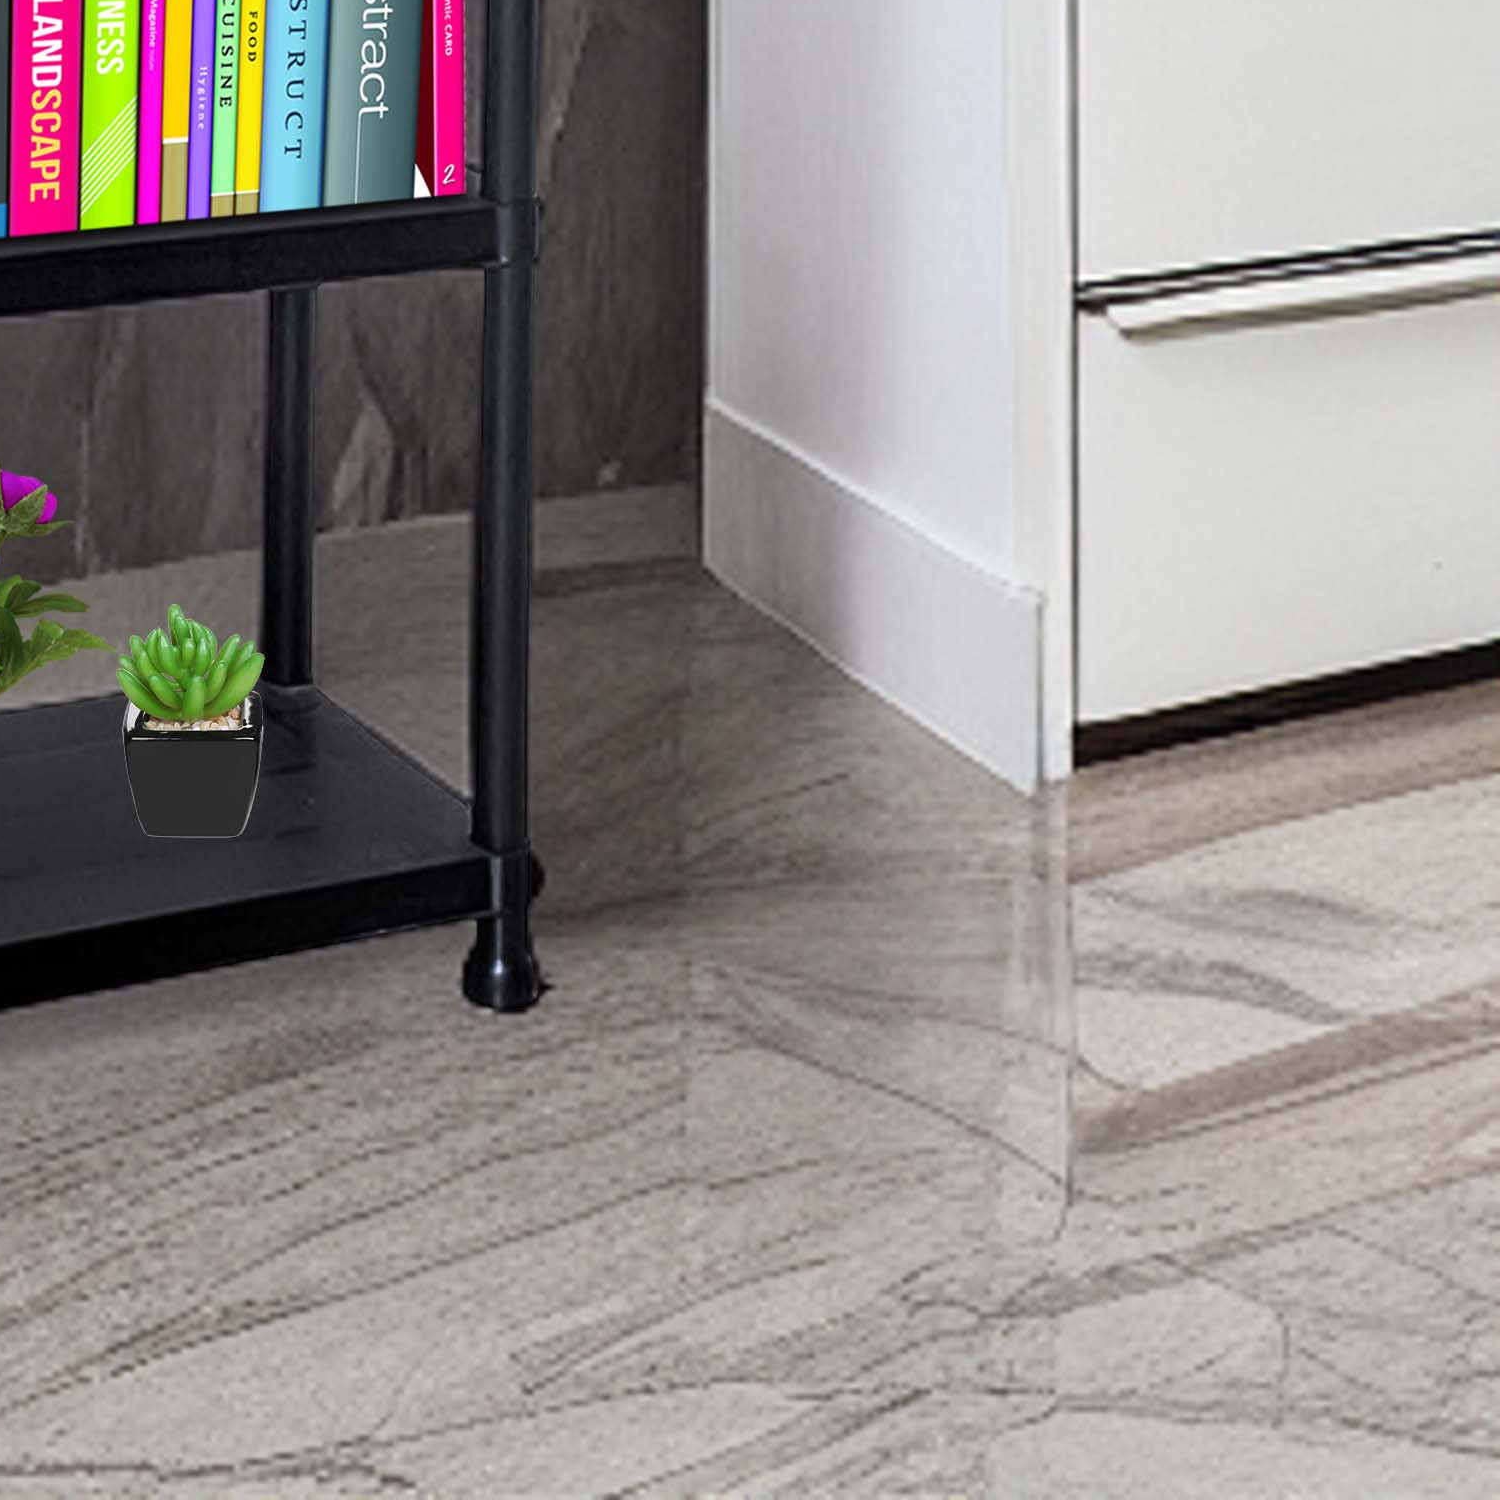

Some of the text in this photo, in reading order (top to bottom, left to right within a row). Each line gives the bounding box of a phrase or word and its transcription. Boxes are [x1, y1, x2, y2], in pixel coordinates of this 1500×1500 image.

[247, 11, 258, 62] FOOD
[444, 24, 453, 56] CARD
[197, 66, 208, 130] Hygiene
[442, 163, 456, 185] 2
